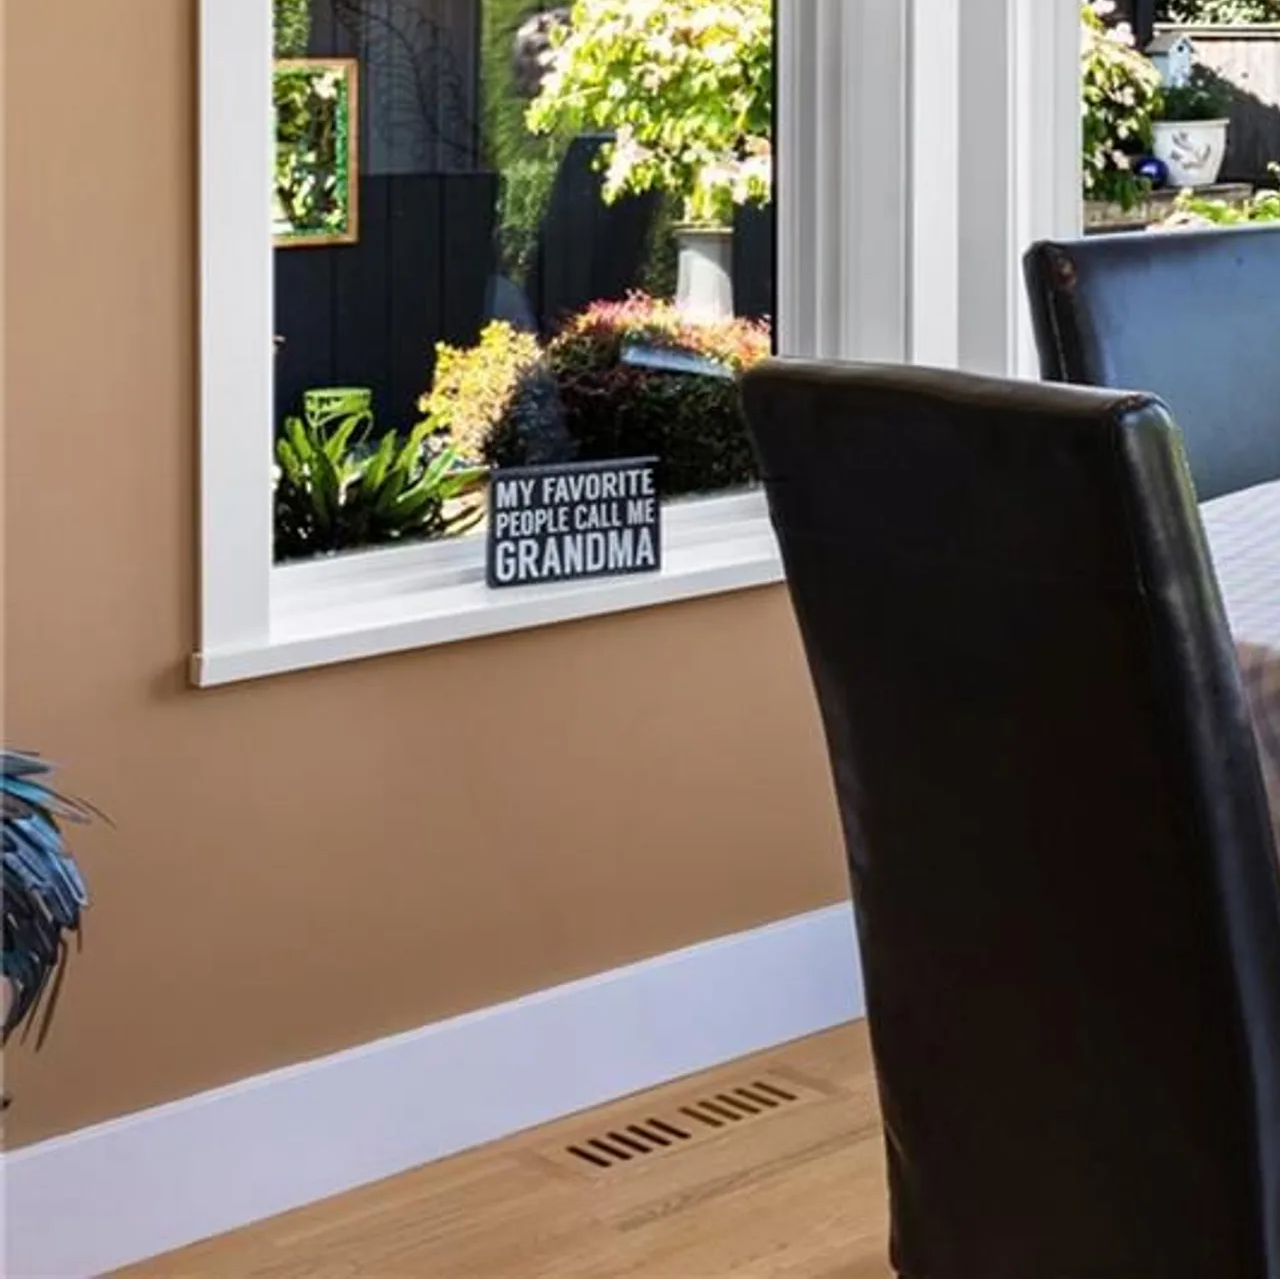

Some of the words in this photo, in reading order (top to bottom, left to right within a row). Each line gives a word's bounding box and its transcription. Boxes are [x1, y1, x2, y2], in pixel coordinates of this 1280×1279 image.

[496, 480, 536, 508] MY
[542, 469, 655, 504] FAVORITE
[496, 506, 569, 539] PEOPLE
[573, 502, 622, 530] CALL
[627, 498, 655, 525] ME
[495, 527, 656, 582] GRANDMA
